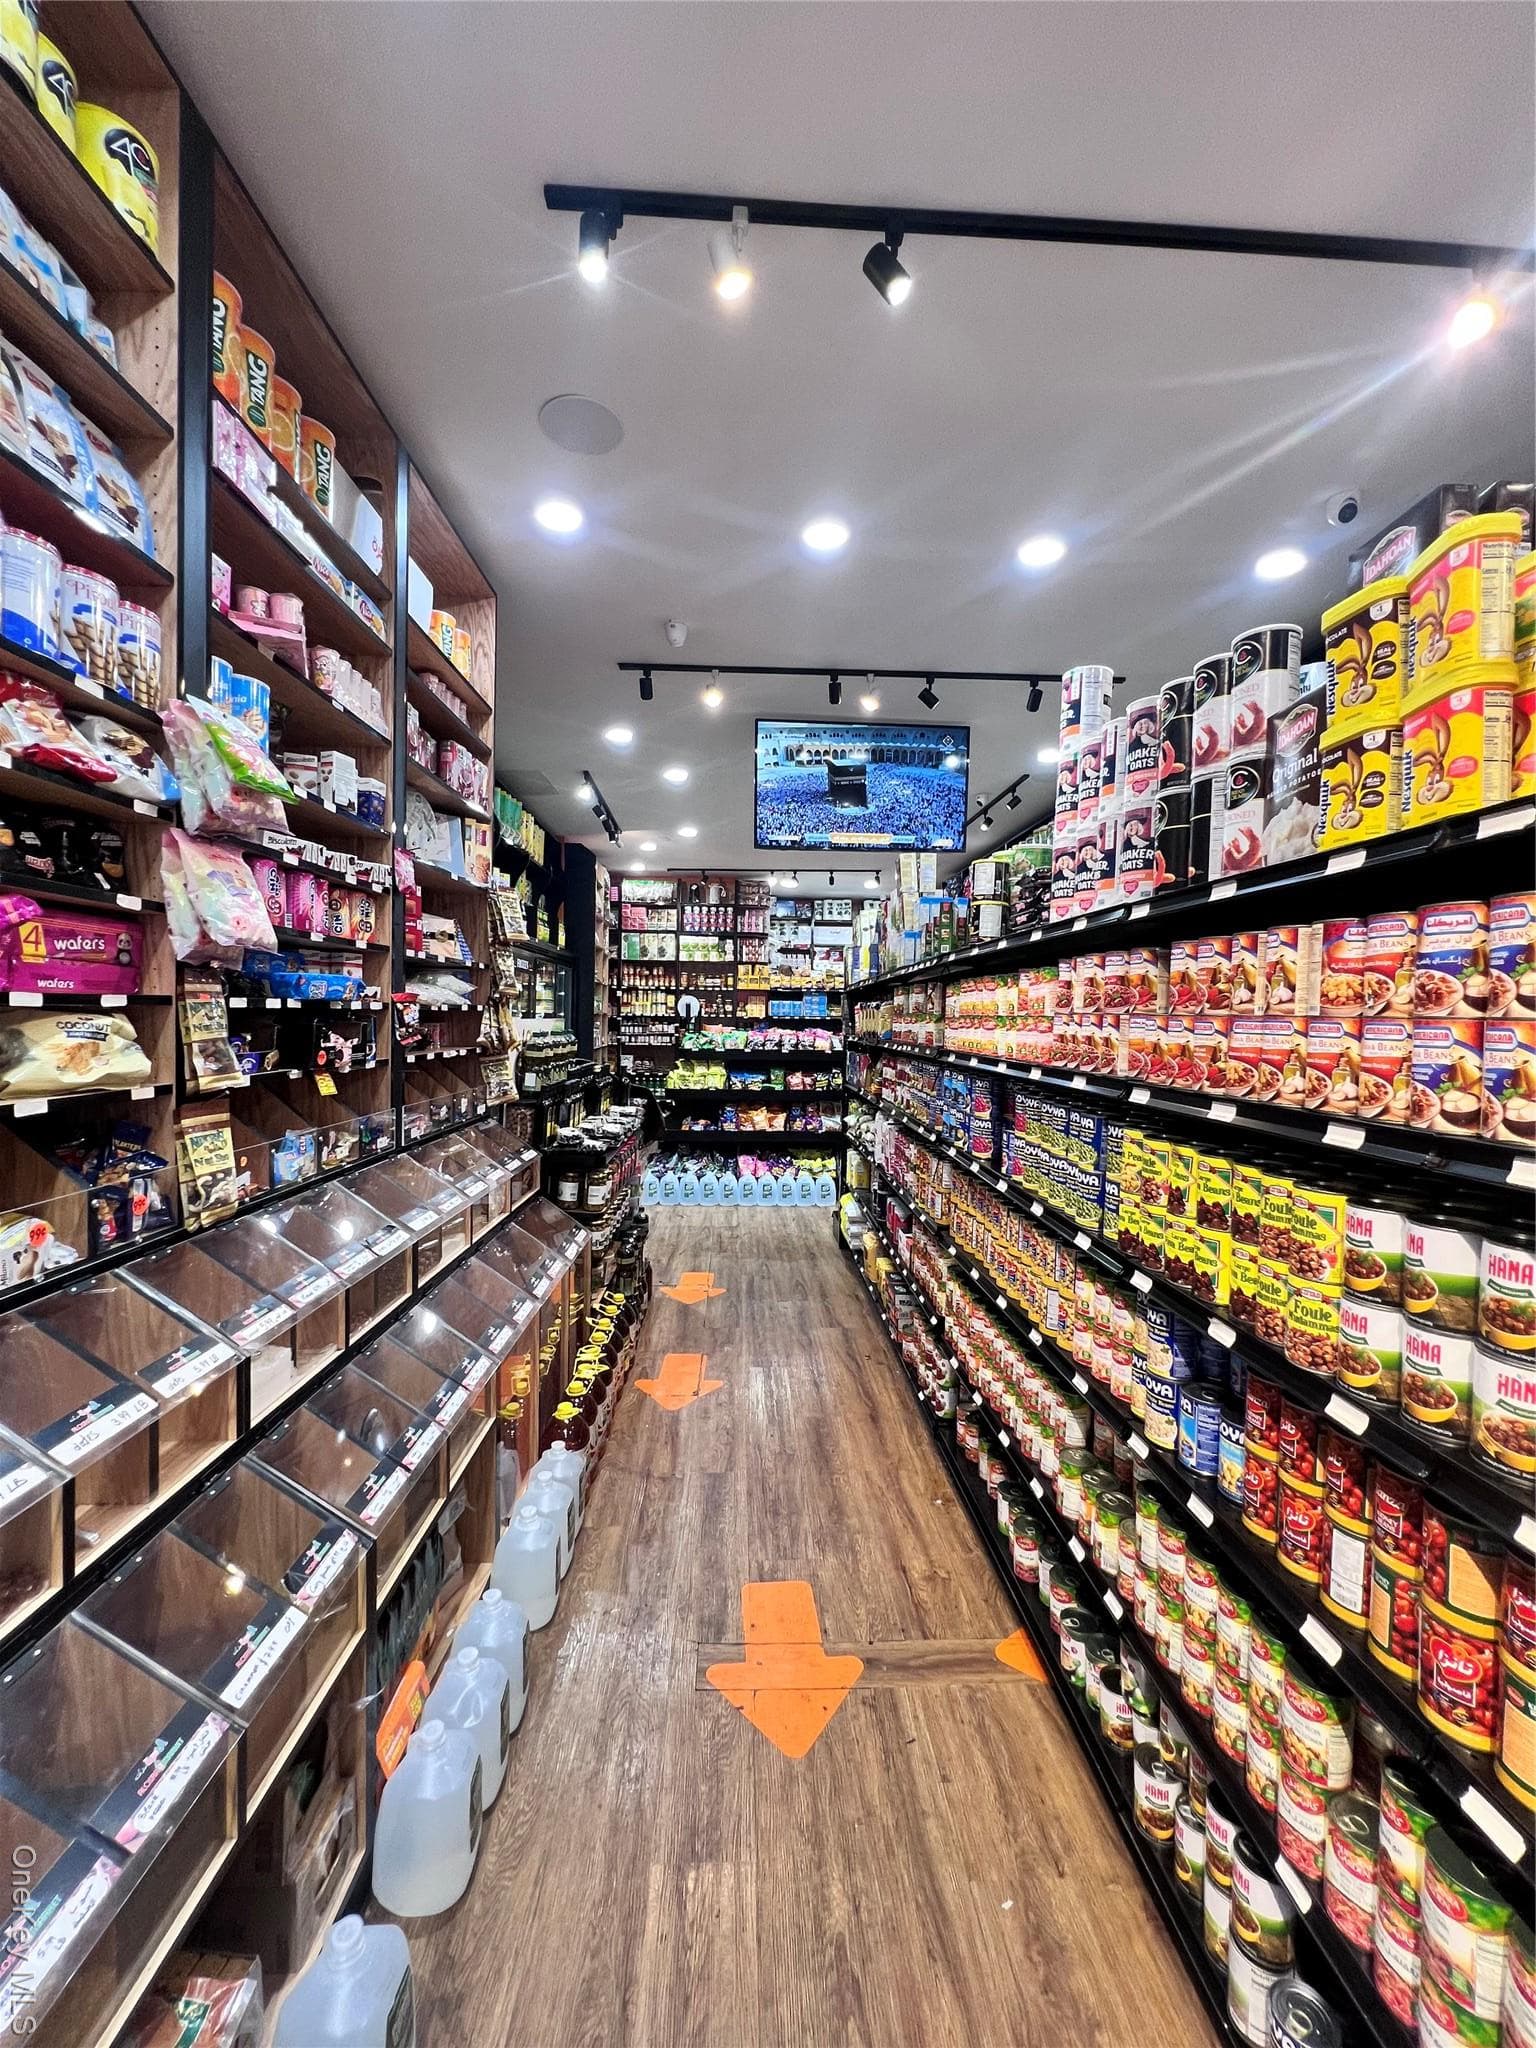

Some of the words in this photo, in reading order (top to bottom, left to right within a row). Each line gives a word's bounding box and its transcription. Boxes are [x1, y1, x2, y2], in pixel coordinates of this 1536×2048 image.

[110, 136, 151, 176] 4C
[251, 355, 268, 404] TANG
[319, 445, 331, 488] TANG
[1365, 532, 1414, 580] IDAHOAN
[1408, 615, 1420, 680] Nesquik
[1327, 657, 1338, 716] Nesquik
[1278, 711, 1316, 750] IDAHOAN
[1130, 757, 1154, 772] OATS
[1273, 748, 1318, 783] Original
[1289, 767, 1322, 790] POTATOE
[1402, 748, 1415, 813] Nesquik
[1320, 778, 1332, 835] Nesquik
[1122, 859, 1143, 871] OATS
[1054, 888, 1074, 899] OATS
[23, 925, 42, 952] 4
[54, 938, 105, 951] wafers
[1379, 939, 1409, 949] BEANS
[1498, 930, 1531, 943] BEANS
[37, 978, 74, 989] wafers
[56, 1020, 110, 1032] COCONUT
[1318, 1039, 1345, 1049] BEANS
[1378, 1041, 1408, 1053] BEANS
[1423, 1048, 1454, 1061] BEANS
[1487, 1051, 1517, 1065] BEANS
[974, 1121, 992, 1130] OYA
[1128, 1152, 1142, 1162] Pea
[1078, 1172, 1099, 1187] OYA
[1203, 1183, 1231, 1196] Beans
[1172, 1232, 1188, 1243] Large
[1234, 1260, 1251, 1271] Large
[1488, 1253, 1534, 1286] HANA
[1294, 1299, 1332, 1322] Foule
[1406, 1333, 1441, 1365] HANA
[1145, 1377, 1174, 1398] OYA
[1497, 1373, 1536, 1405] HAN
[133, 1400, 150, 1415] LB
[1116, 1701, 1132, 1715] HAN
[1144, 1782, 1169, 1801] HANA
